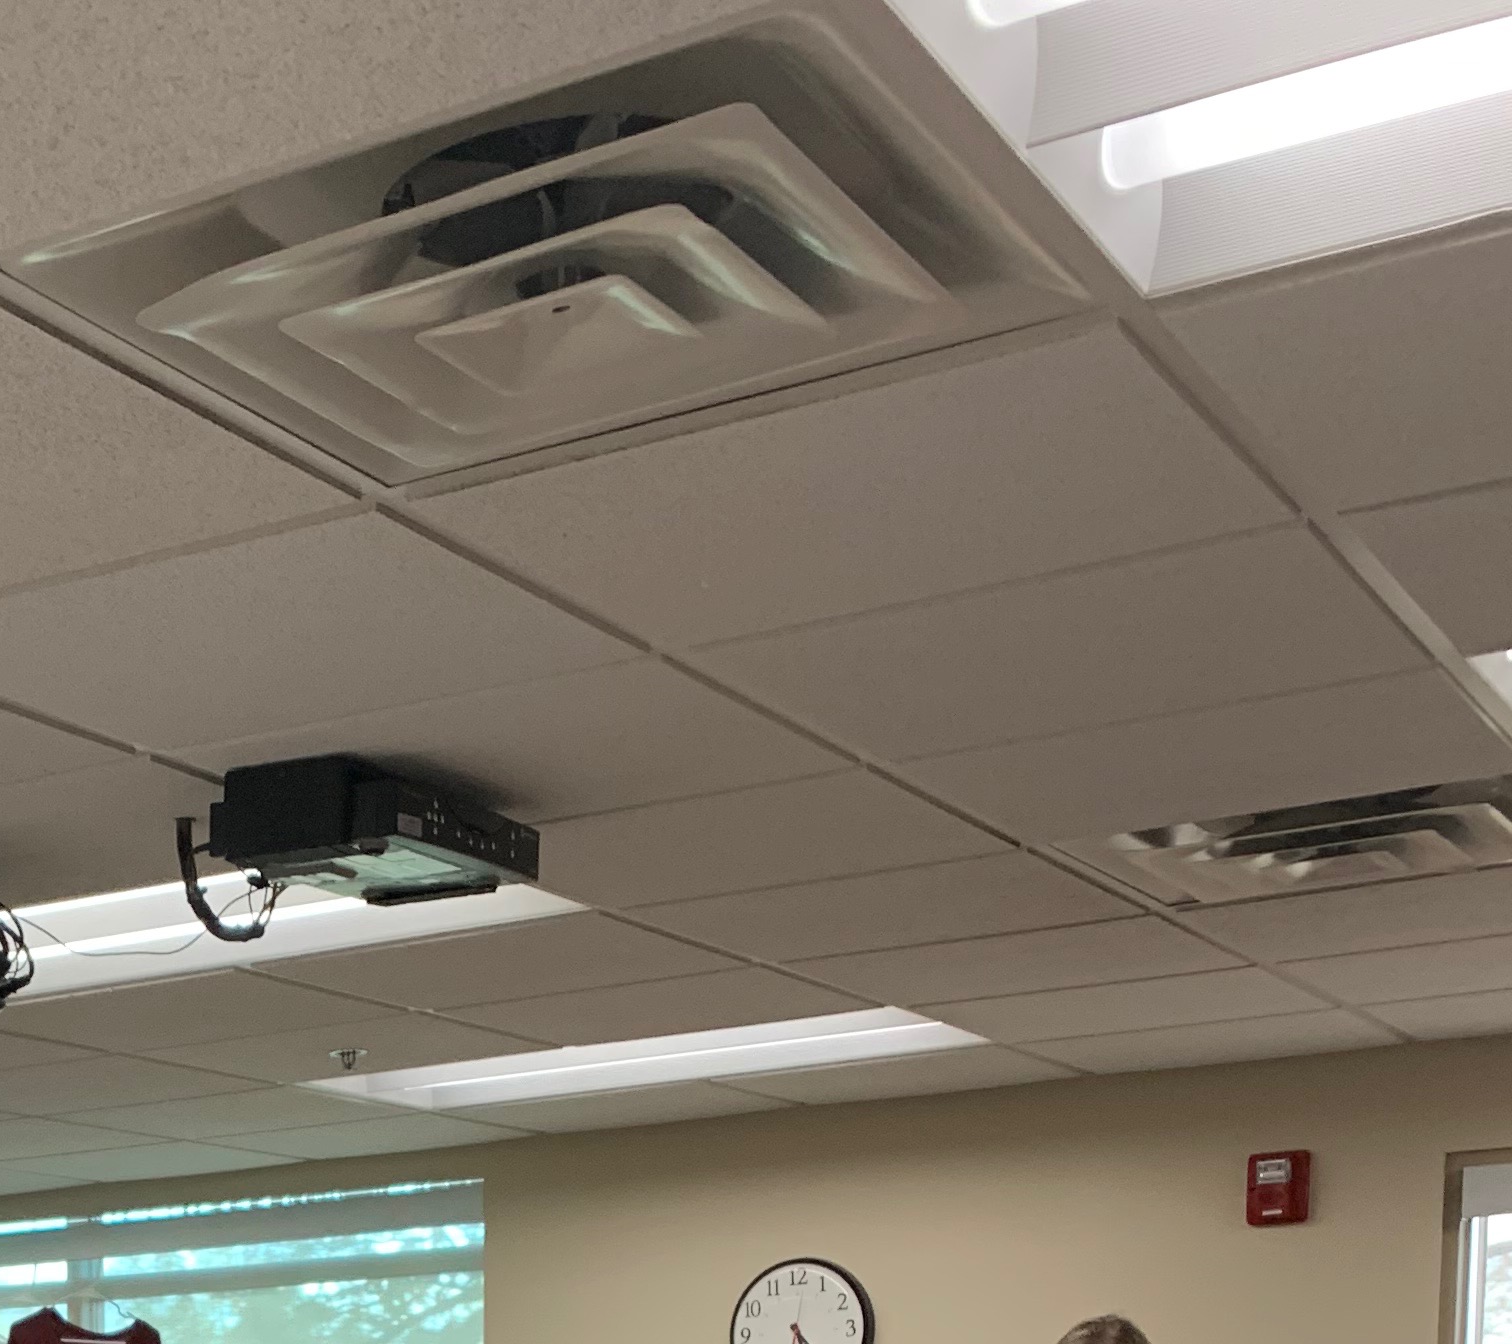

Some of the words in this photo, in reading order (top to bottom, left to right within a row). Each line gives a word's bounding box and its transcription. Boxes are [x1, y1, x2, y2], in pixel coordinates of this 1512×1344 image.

[790, 1269, 808, 1286] 12
[819, 1275, 826, 1292] 1
[767, 1279, 780, 1296] 11
[745, 1300, 761, 1318] 10
[837, 1293, 848, 1310] 2
[740, 1327, 751, 1344] 9
[845, 1319, 856, 1337] 3
